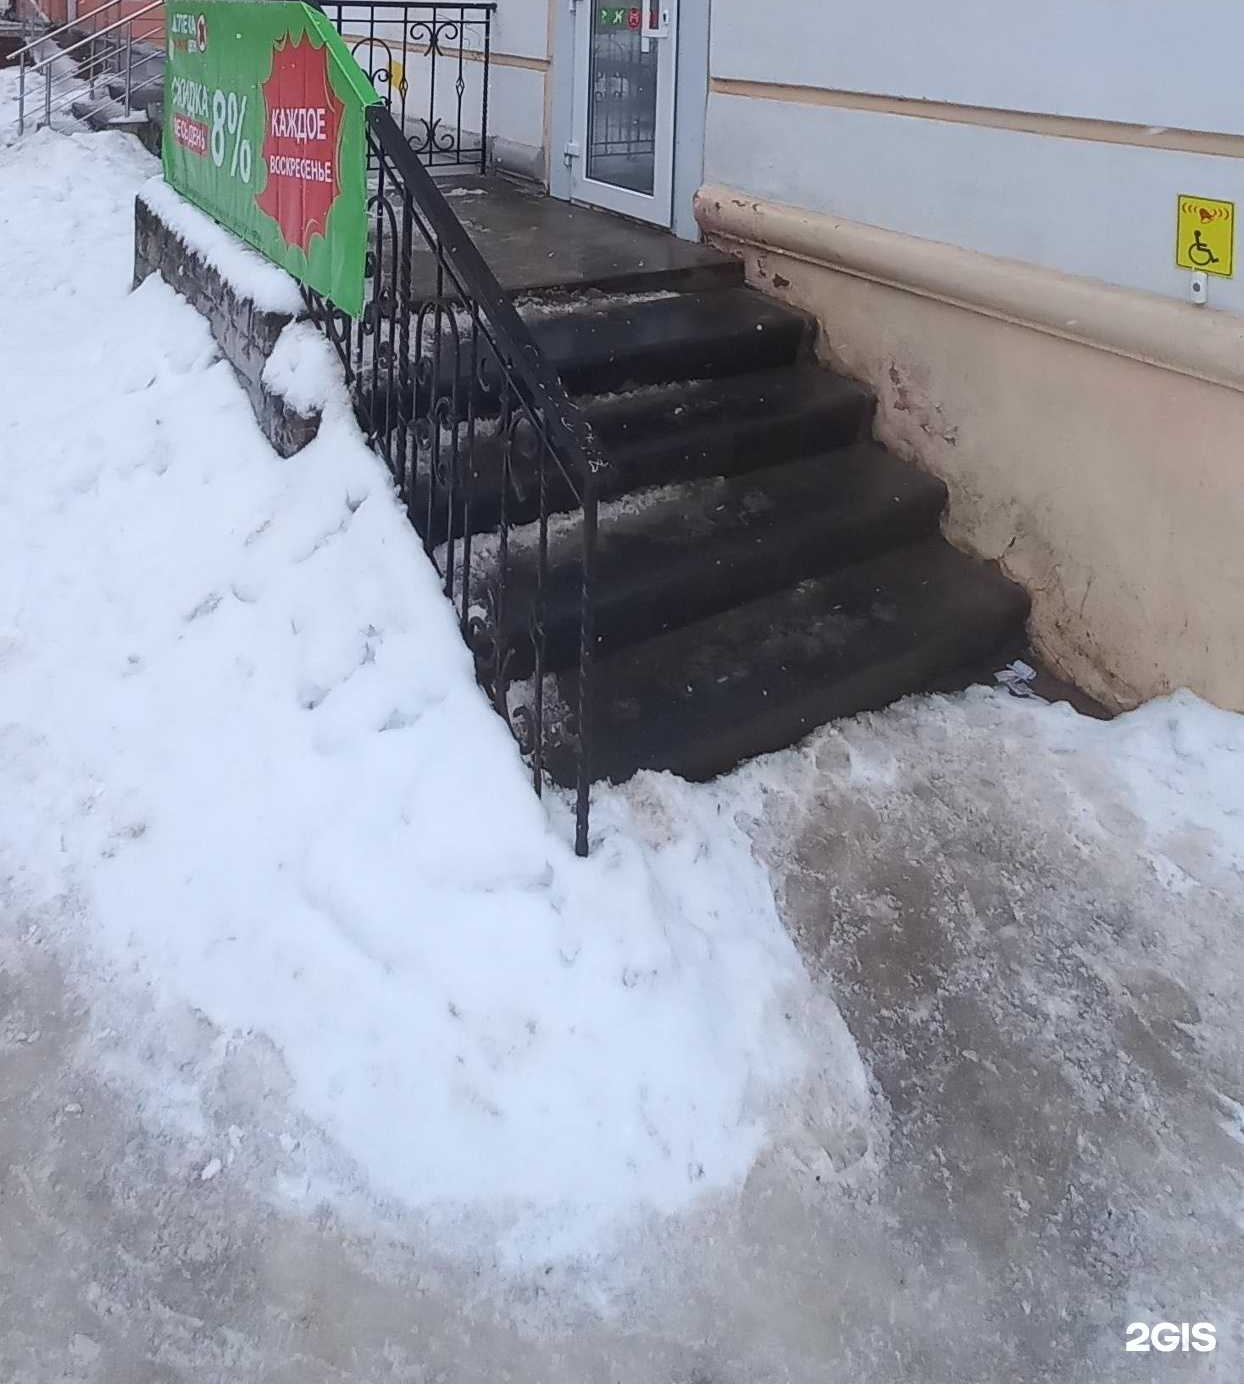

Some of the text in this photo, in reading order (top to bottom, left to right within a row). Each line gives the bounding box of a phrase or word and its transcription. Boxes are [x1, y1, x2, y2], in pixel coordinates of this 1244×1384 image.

[211, 89, 252, 184] 8%
[271, 107, 328, 145] КАЖДОЕ
[268, 154, 334, 184] ВОСКРЕСЕНЬЕ
